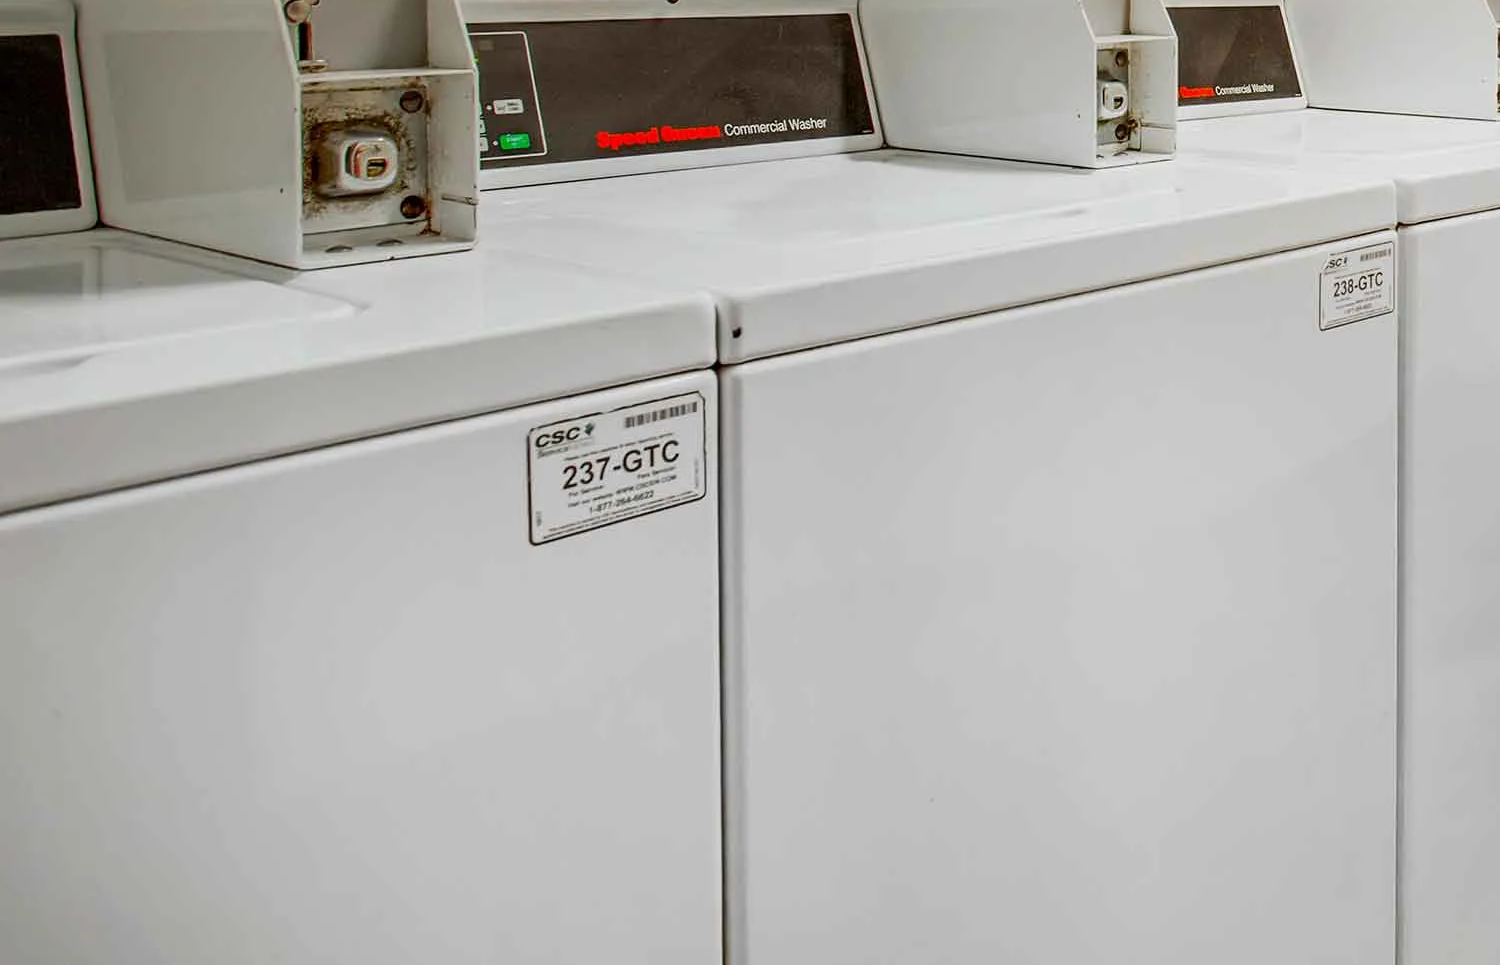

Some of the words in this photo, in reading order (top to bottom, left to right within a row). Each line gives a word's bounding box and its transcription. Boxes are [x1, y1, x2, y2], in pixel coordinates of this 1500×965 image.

[724, 119, 787, 136] Commercial
[788, 117, 828, 130] Washer
[1333, 272, 1384, 297] 238-GTC
[535, 426, 580, 448] CSC
[562, 439, 680, 490] 237-GTC
